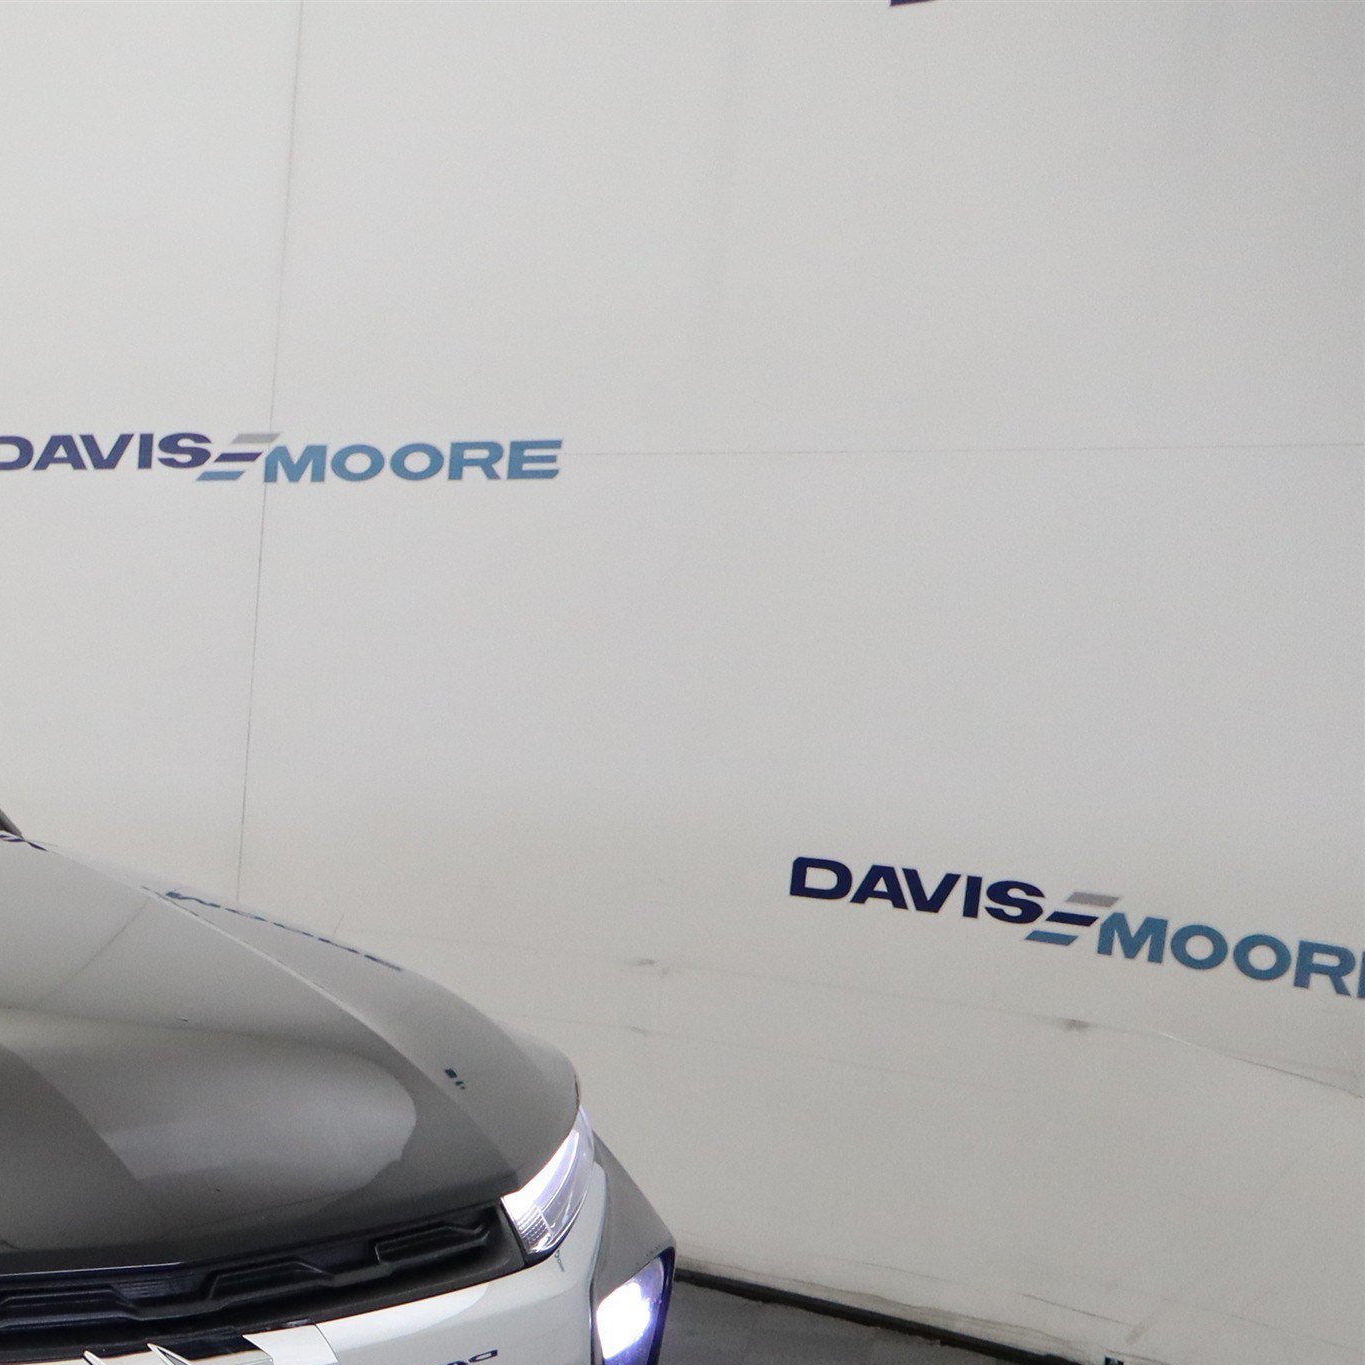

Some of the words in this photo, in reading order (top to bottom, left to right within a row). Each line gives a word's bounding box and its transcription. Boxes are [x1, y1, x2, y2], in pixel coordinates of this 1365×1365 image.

[263, 439, 563, 484] MOORE
[788, 856, 1046, 925] DAVIS
[1096, 911, 1365, 1000] MOOR
